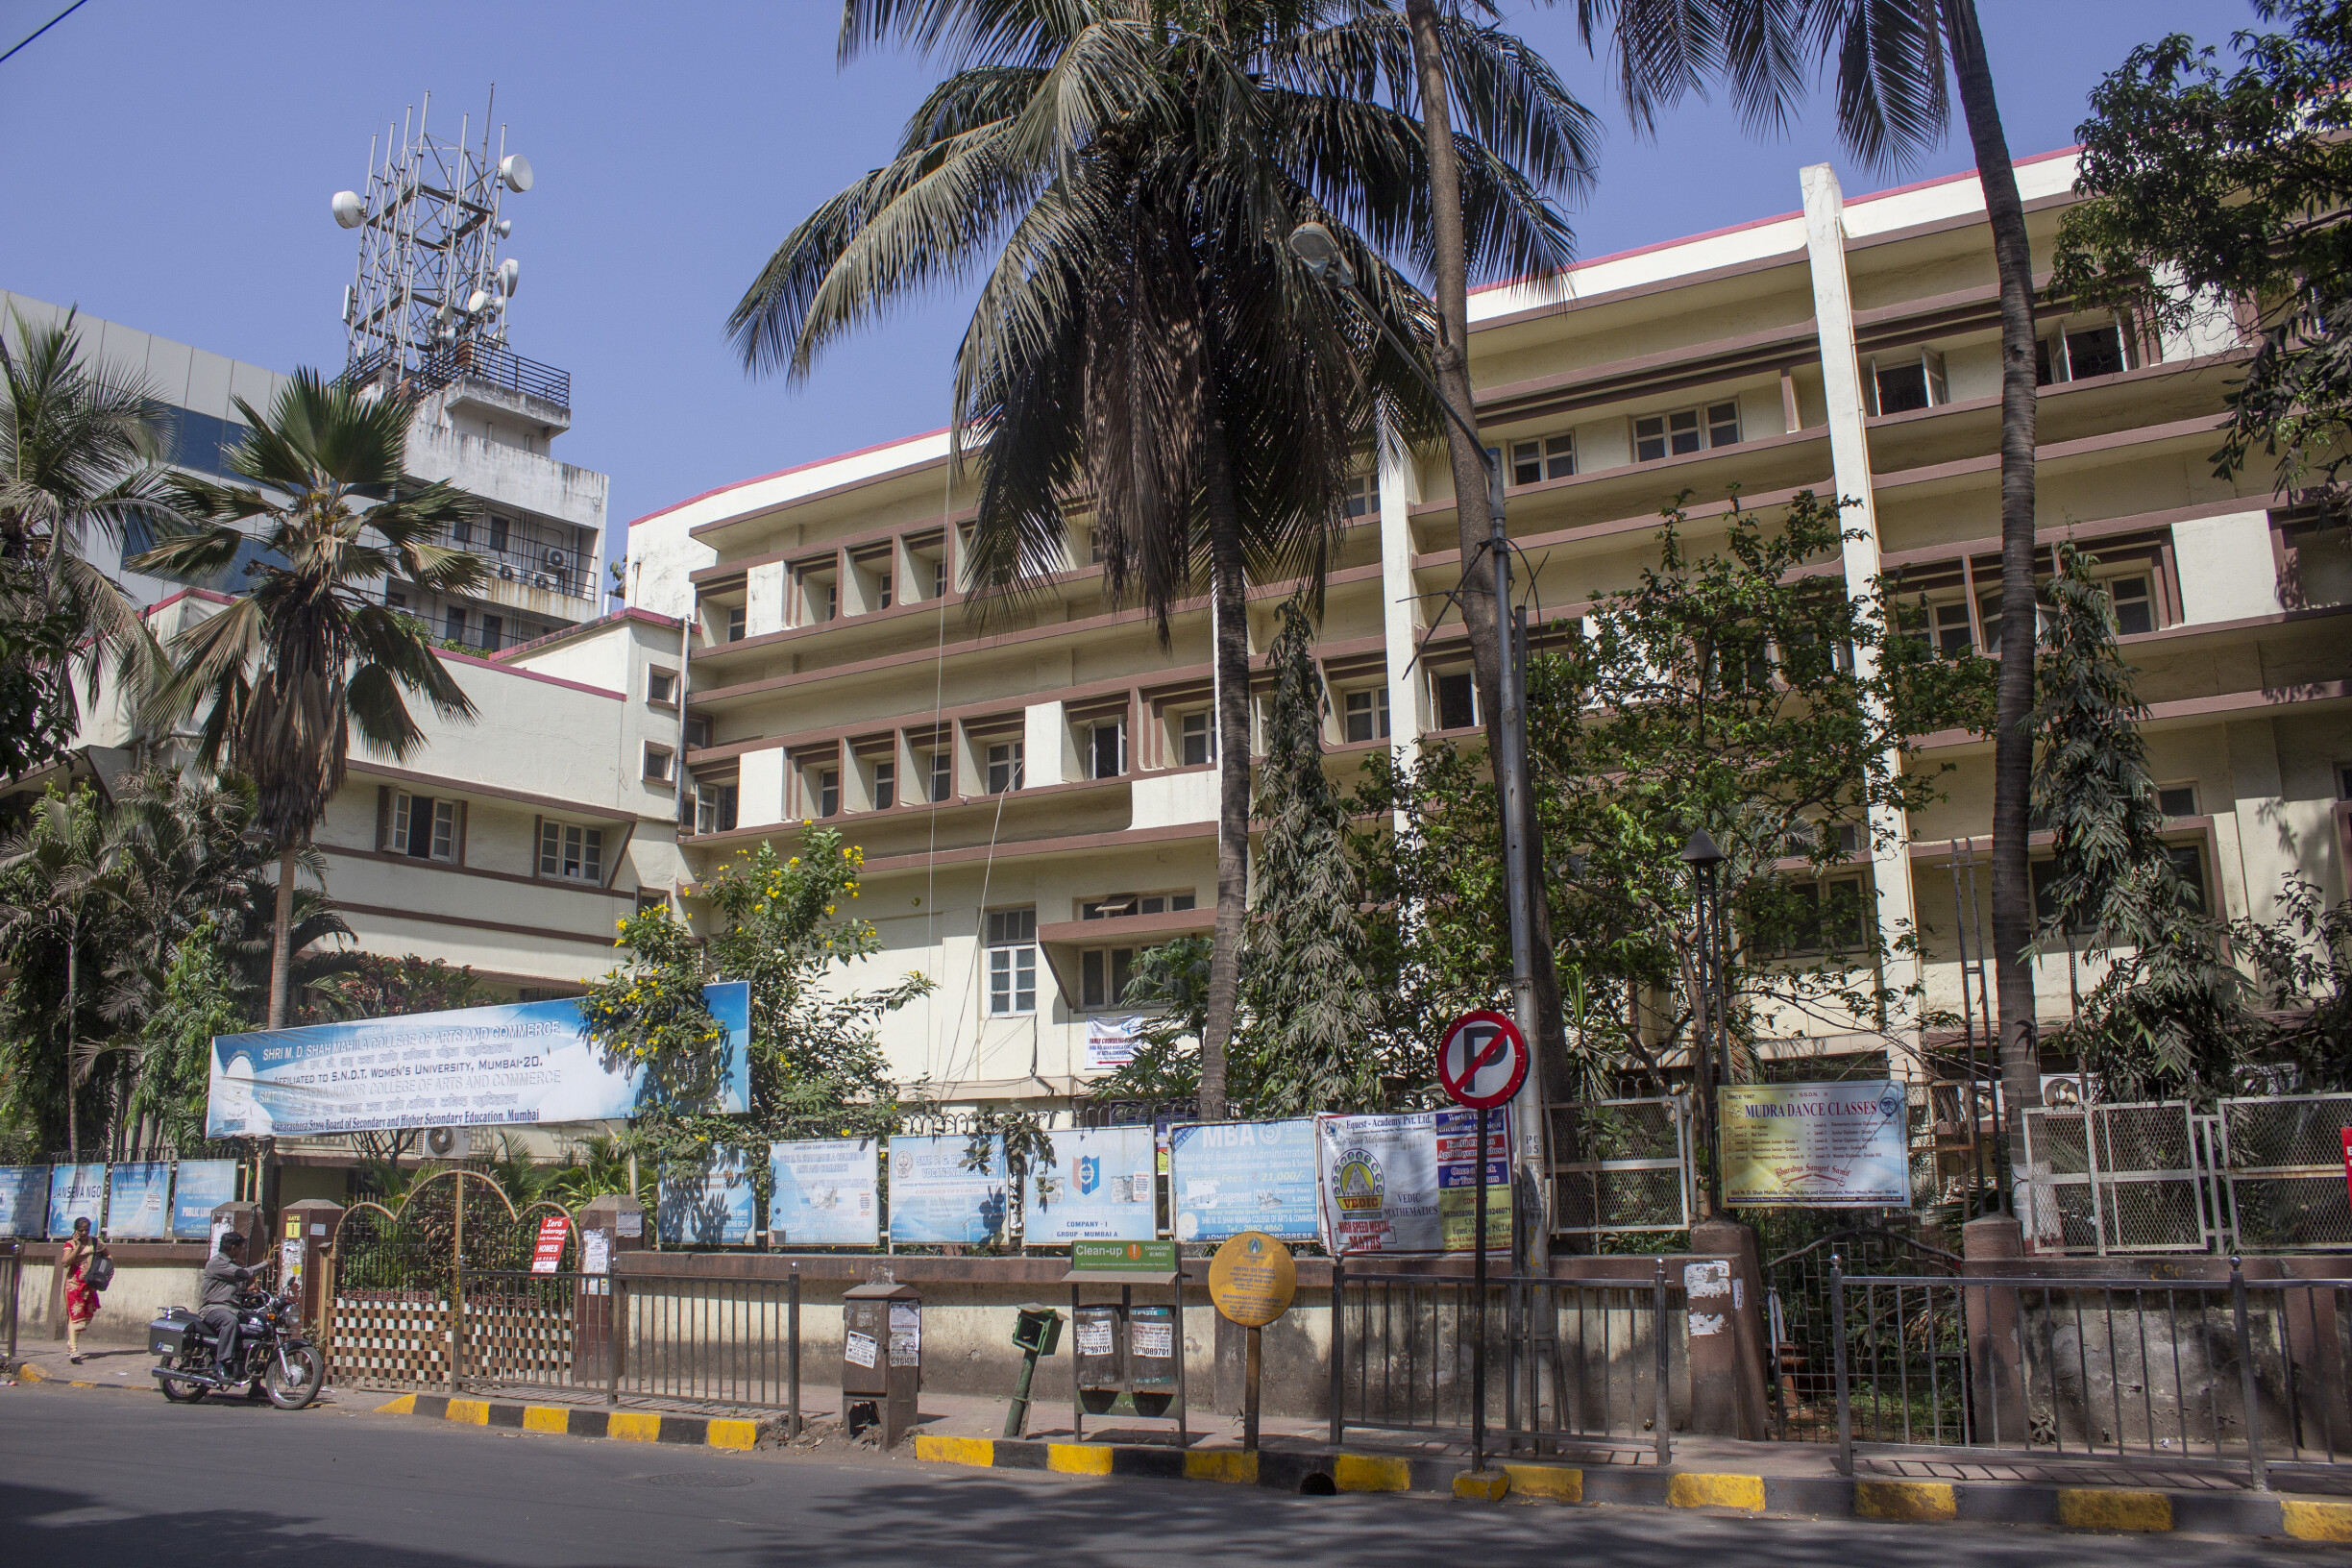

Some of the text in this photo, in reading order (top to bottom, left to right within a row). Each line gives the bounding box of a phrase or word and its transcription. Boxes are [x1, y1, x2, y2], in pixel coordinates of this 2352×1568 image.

[263, 1020, 561, 1061] SHRI M. D. SHAH MAHILA COLLEGE OF ARTS AND COMMERCE
[331, 1068, 368, 1082] S.N.D.T.
[371, 1066, 411, 1078] WOMEN'S
[415, 1062, 475, 1075] UNIVERSITY,
[478, 1056, 543, 1070] MUMBAI-20.
[331, 1083, 366, 1098] JUNIOR
[370, 1079, 416, 1095] COLLEGE
[418, 1078, 432, 1092] OF
[434, 1076, 463, 1090] ARTS
[466, 1074, 490, 1089] AND
[492, 1070, 561, 1088] COMMERCE
[1745, 1101, 1877, 1118] MUDRA DANCE CLASSES
[326, 1118, 344, 1130] Board
[346, 1117, 352, 1129] of
[353, 1116, 386, 1131] Secondary
[386, 1115, 400, 1127] and
[400, 1114, 424, 1128] Higher
[425, 1111, 463, 1126] Secondary
[507, 1108, 540, 1122] Mumbai
[1346, 1120, 1367, 1131] Equest
[1372, 1117, 1401, 1128] Academy
[1403, 1115, 1416, 1125] Pvt.
[1418, 1115, 1433, 1124] Ltd.
[1448, 1113, 1473, 1121] World's
[1438, 1124, 1473, 1133] calculating
[1203, 1124, 1256, 1148] MBA
[1176, 1147, 1313, 1163] Master of Business Administration
[1438, 1149, 1454, 1159] Aged
[922, 1167, 965, 1179] VOCATIONAL
[1221, 1174, 1243, 1183] Fees
[1261, 1170, 1305, 1183] 21,000/-
[1451, 1166, 1469, 1176] Once
[1449, 1177, 1477, 1186] for Two
[53, 1185, 102, 1199] JANSEVA NGO
[1398, 1193, 1421, 1203] VEDIC
[1343, 1197, 1379, 1209] VEDIC
[1384, 1206, 1438, 1217] MATHEMATICS
[1252, 1214, 1270, 1223] COLLEGE
[1277, 1214, 1288, 1223] ARTS
[291, 1223, 295, 1236] 1
[1338, 1220, 1390, 1234] HIGH SPEED MENTAL
[538, 1244, 559, 1253] HOMES
[1349, 1235, 1382, 1249] MATHS
[1076, 1245, 1123, 1258] Clean-up
